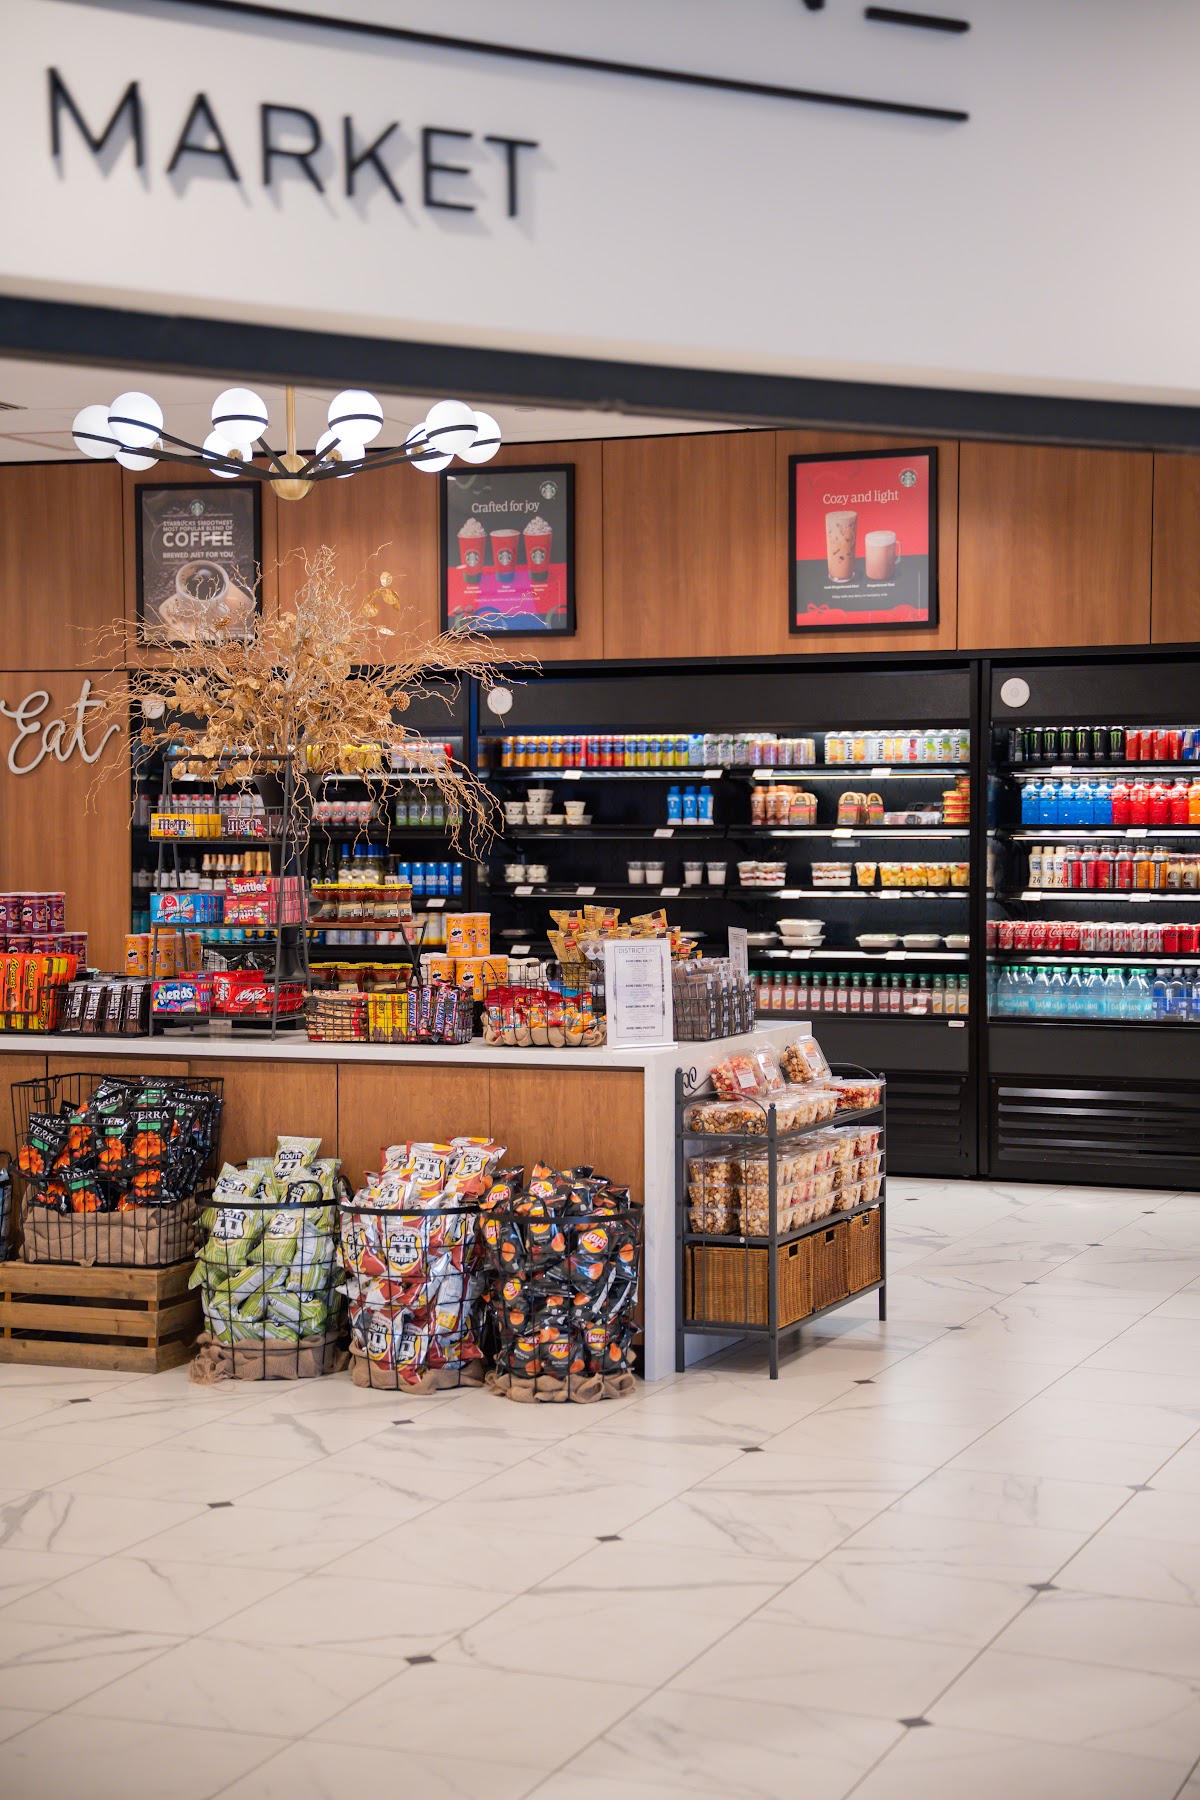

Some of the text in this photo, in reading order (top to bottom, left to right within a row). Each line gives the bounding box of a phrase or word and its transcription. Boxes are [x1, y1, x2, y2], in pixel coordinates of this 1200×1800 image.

[47, 66, 540, 218] MARKET
[823, 489, 899, 505] Cozy and light
[471, 500, 540, 513] Crafted for joy
[0, 679, 120, 774] Eat
[232, 882, 267, 894] Skittles
[129, 1110, 170, 1119] TERRA
[29, 1122, 60, 1146] TERRA
[280, 1151, 303, 1160] ROUTE
[219, 1179, 246, 1192] ROUTE
[217, 1209, 246, 1221] ROUTE
